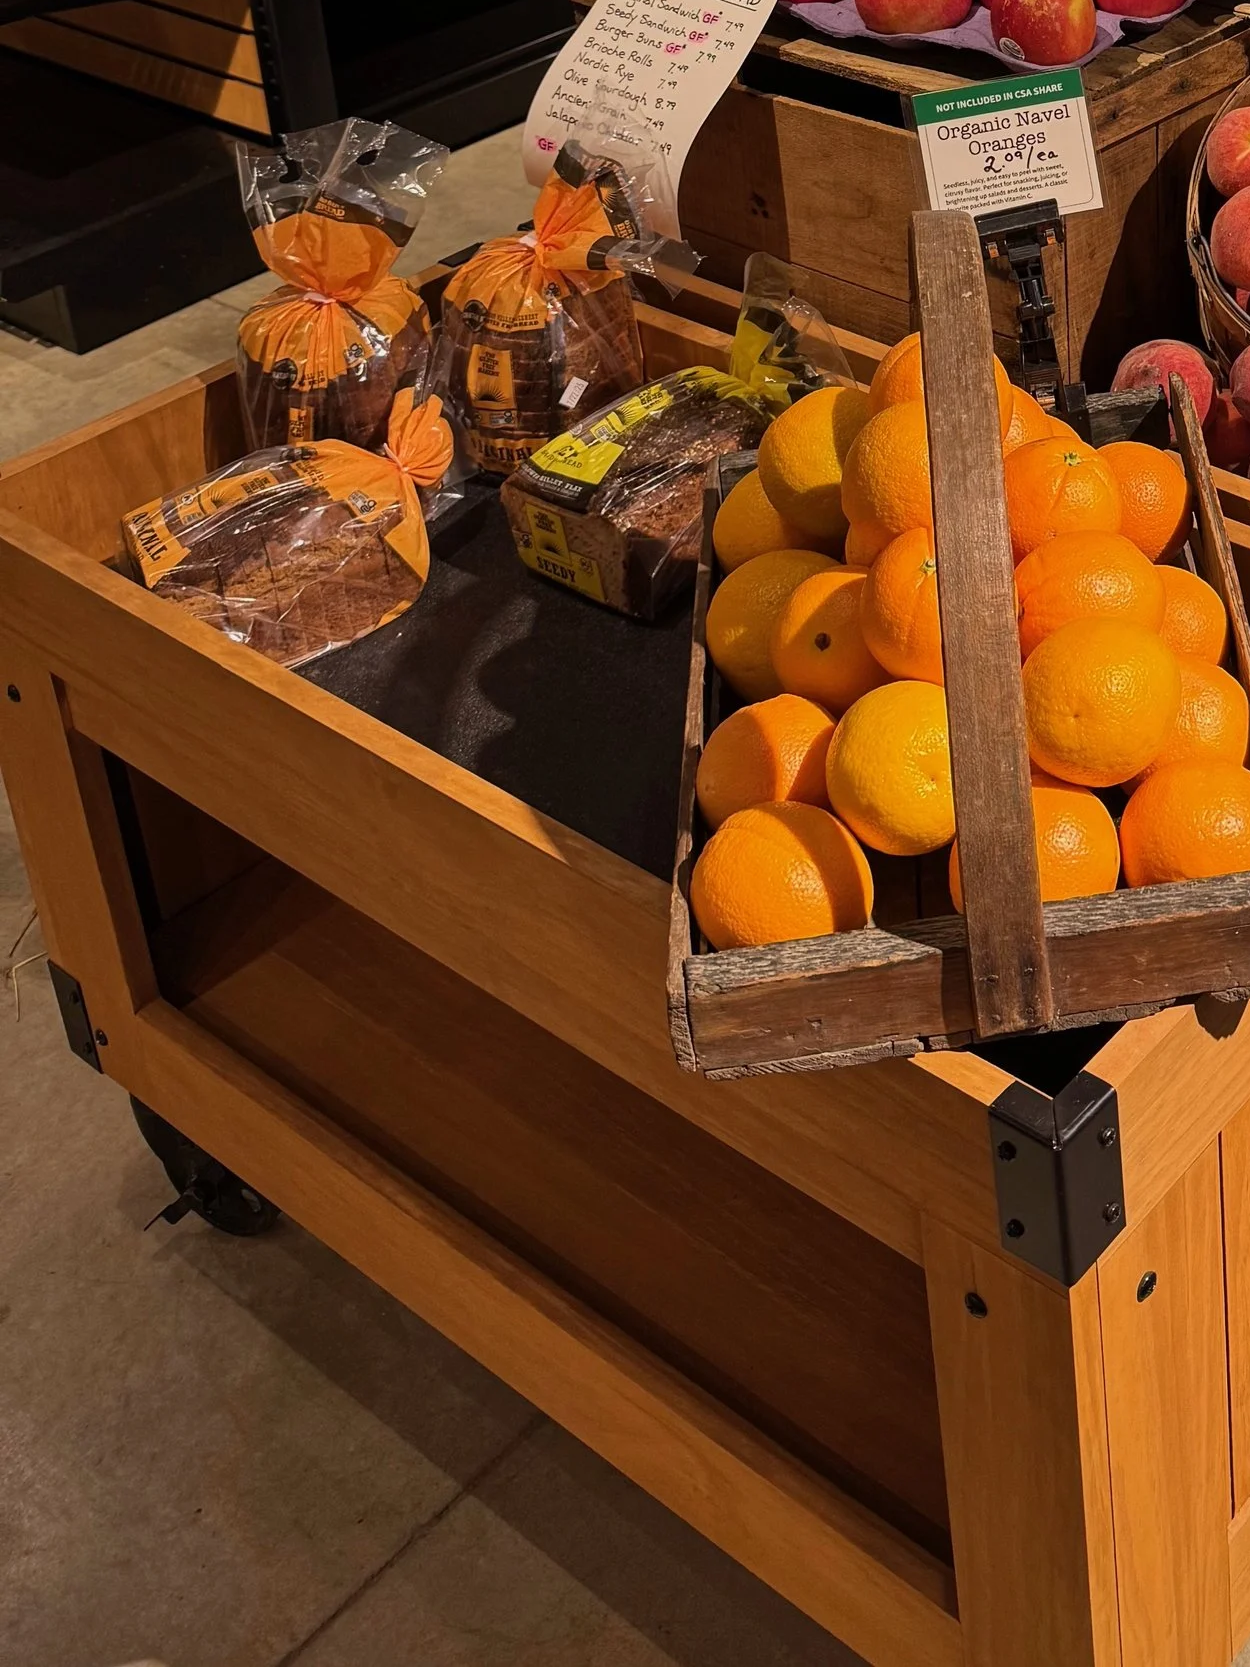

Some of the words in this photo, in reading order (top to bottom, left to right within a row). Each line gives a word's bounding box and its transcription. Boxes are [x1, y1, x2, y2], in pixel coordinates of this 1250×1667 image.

[606, 3, 638, 25] Seedy
[640, 14, 688, 38] Sandwich
[715, 39, 735, 50] 7.49
[726, 20, 745, 33] 7.49
[584, 36, 626, 59] Brioche
[627, 50, 654, 68] Rolls
[668, 62, 689, 74] 7.49
[595, 18, 634, 41] Burger
[636, 32, 664, 49] Buns
[696, 50, 717, 64] 7.99
[574, 52, 610, 72] Nordic
[616, 64, 635, 82] Rye
[564, 68, 588, 86] Olive
[595, 78, 648, 112] Sourdough
[654, 97, 677, 110] 8.79
[936, 102, 956, 113] NOT
[956, 94, 1002, 110] INCLUDED
[1003, 92, 1014, 102] IN
[1014, 88, 1032, 99] CSA
[1033, 83, 1064, 96] SHARE
[598, 102, 628, 121] Grain
[646, 118, 665, 131] 7.49
[937, 116, 1012, 141] Organic
[1014, 104, 1072, 127] Navel
[650, 140, 672, 155] 7.49
[968, 132, 1046, 156] Oranges
[943, 181, 970, 190] Seedless,
[970, 178, 986, 186] juicy,
[1019, 169, 1031, 178] peel
[945, 189, 964, 198] citrusy
[965, 186, 982, 194] flavor.
[983, 182, 1003, 190] Perfect
[1013, 176, 1039, 185] snacking,
[1040, 172, 1061, 181] juicing,
[946, 194, 979, 206] brightening
[988, 189, 1006, 197] salads
[1019, 184, 1043, 193] desserts.
[970, 201, 990, 210] packed
[1005, 195, 1026, 203] Vitamin
[536, 556, 576, 583] SEEDY
